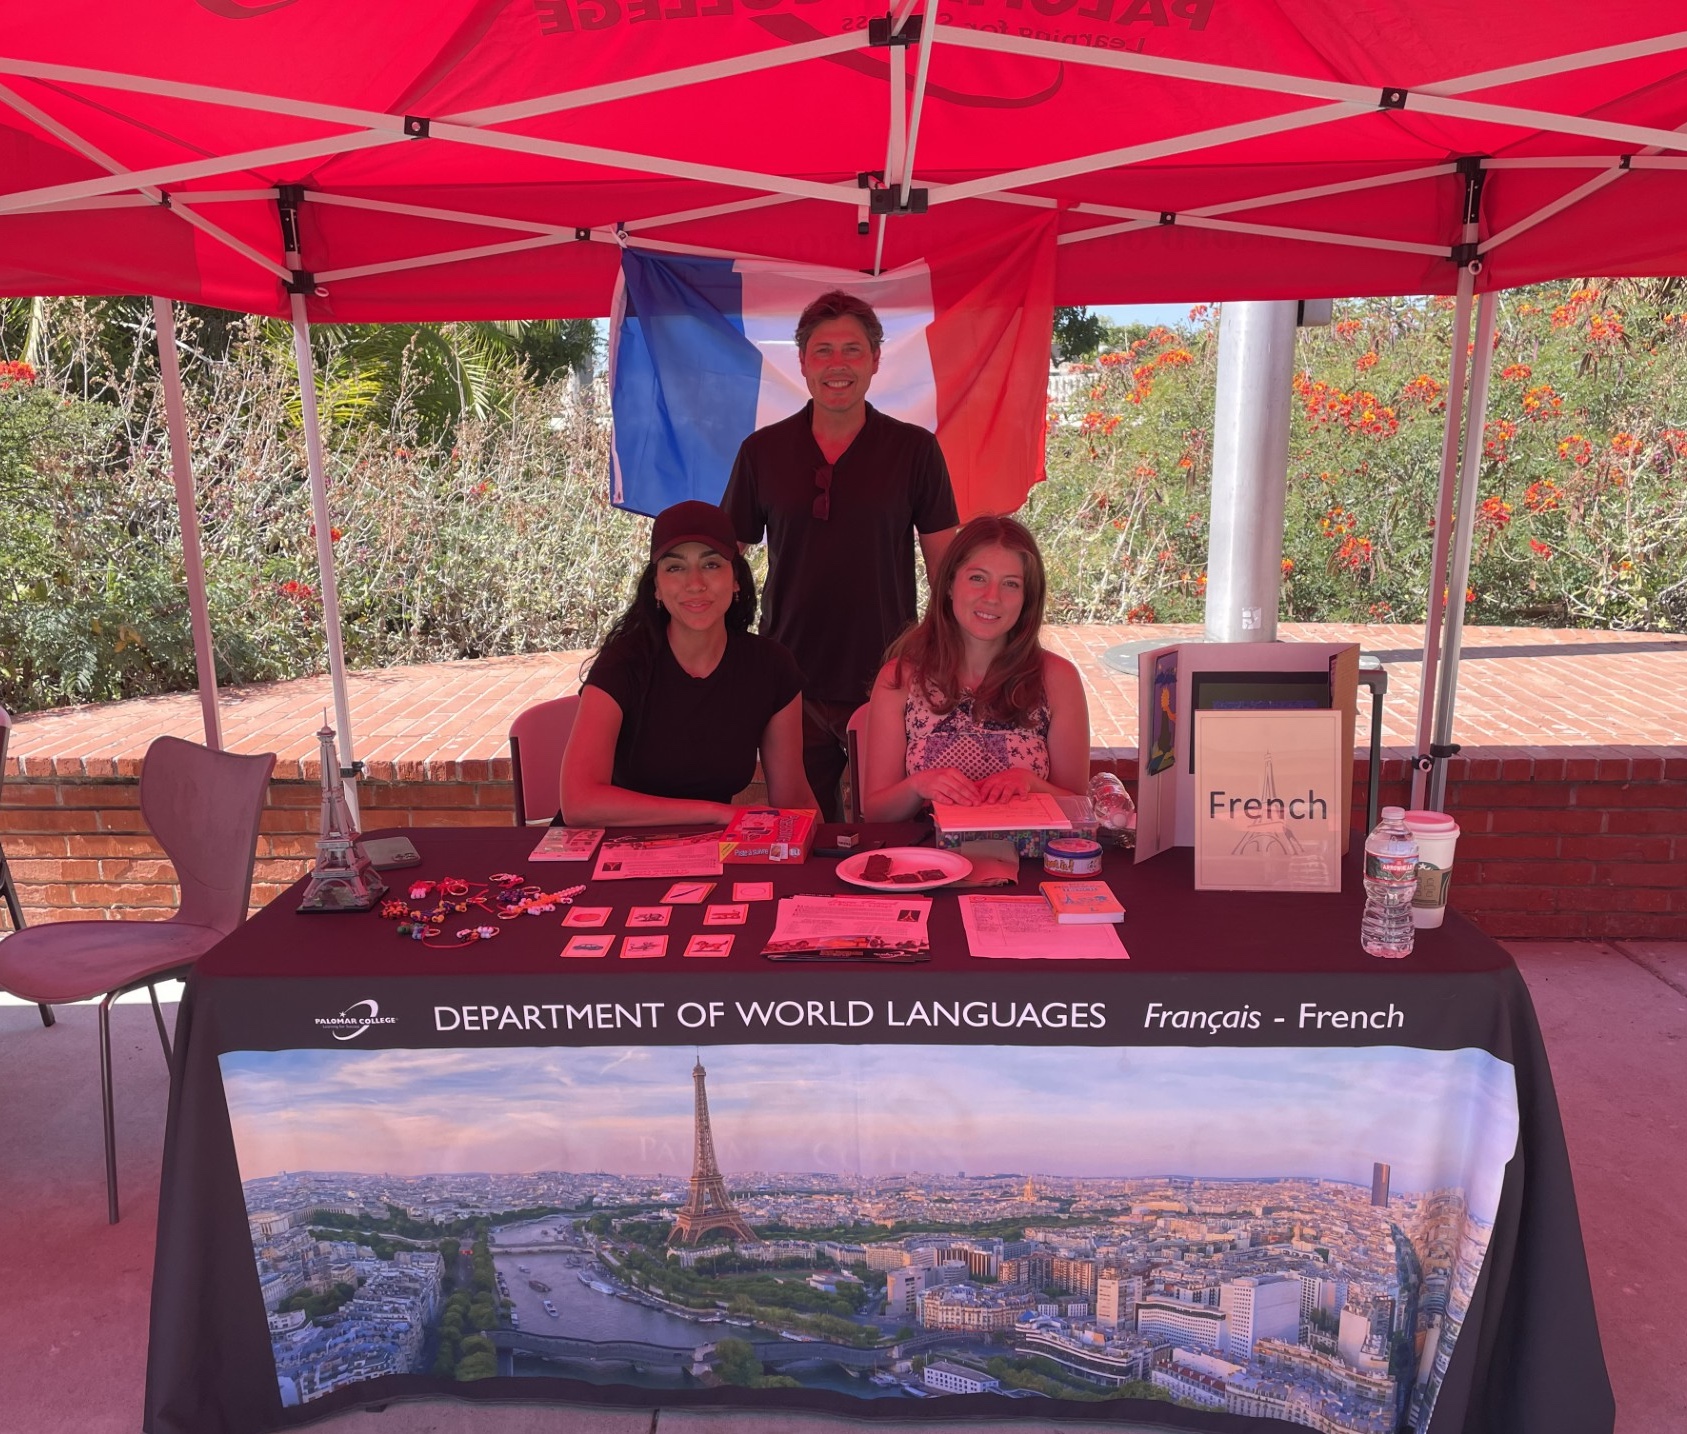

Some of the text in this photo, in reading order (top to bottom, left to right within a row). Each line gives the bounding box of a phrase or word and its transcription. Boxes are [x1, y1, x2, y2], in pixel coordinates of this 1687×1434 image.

[1209, 789, 1328, 820] French
[358, 1017, 396, 1025] COLLEGE
[434, 1000, 1106, 1031] DEPARTMENT OF WORLD LANGUAGES
[1144, 1002, 1262, 1035] Français
[1298, 1003, 1405, 1029] French
